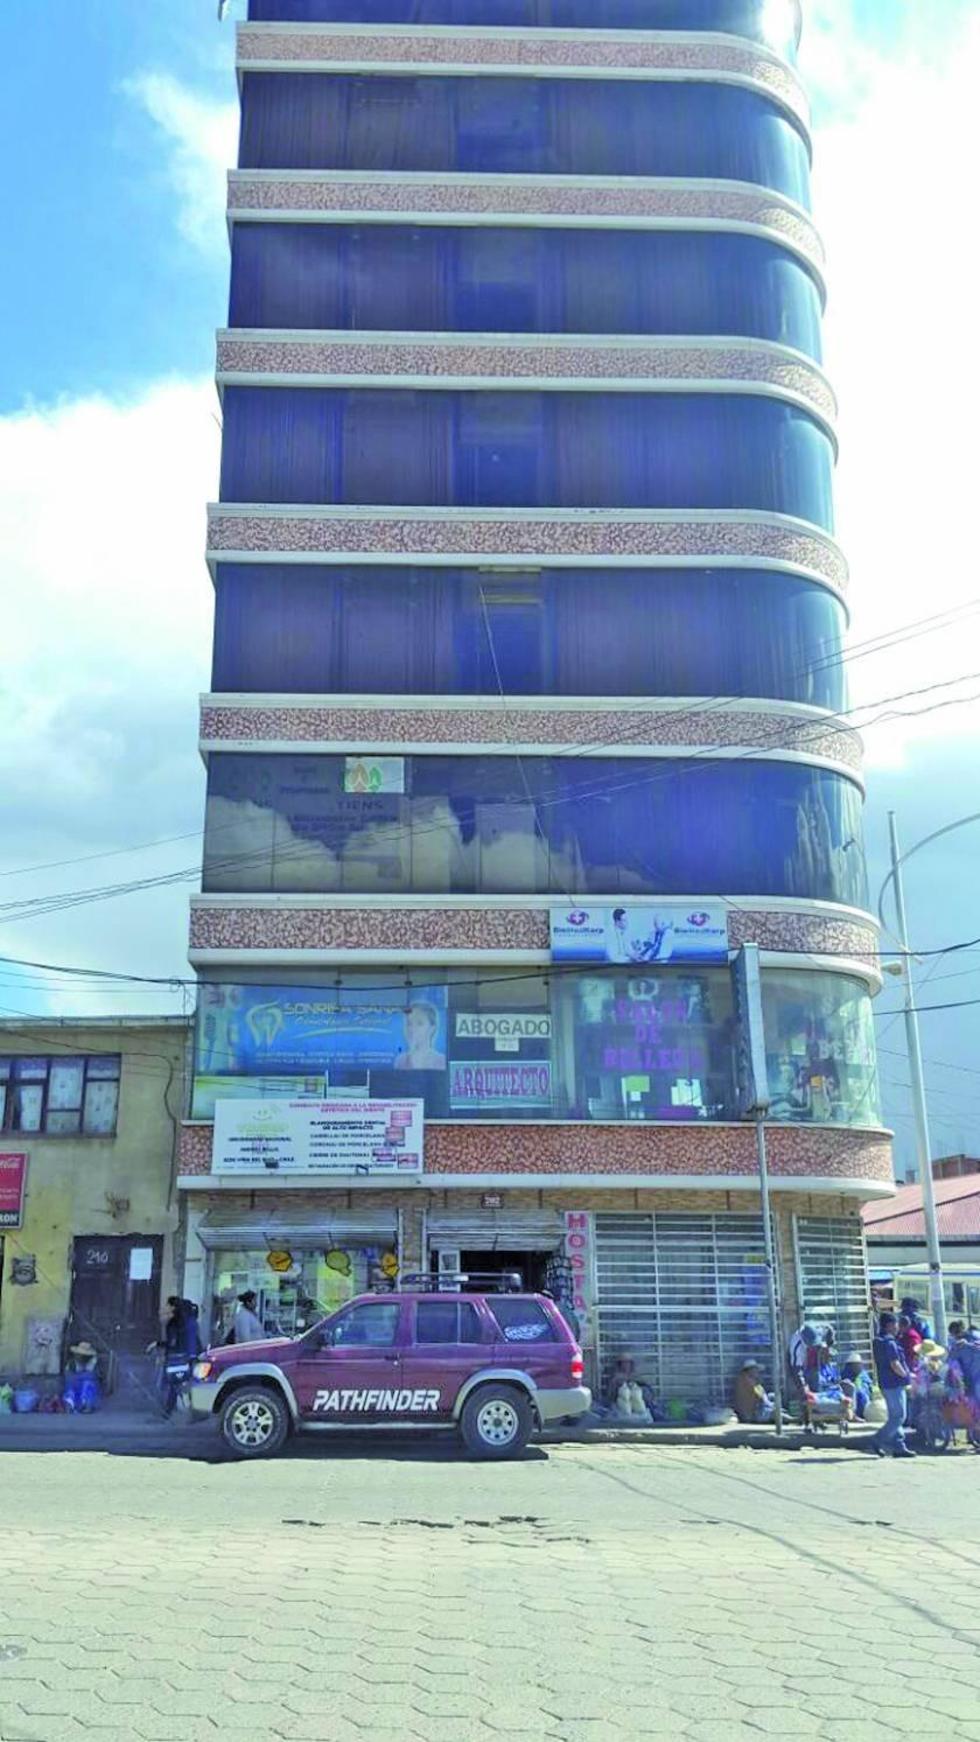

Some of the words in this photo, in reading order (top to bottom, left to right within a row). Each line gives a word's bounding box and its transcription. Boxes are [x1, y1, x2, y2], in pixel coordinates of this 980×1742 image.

[458, 1019, 550, 1035] ABOGADO
[635, 1024, 661, 1043] DE
[455, 1066, 549, 1098] ARQUITECTO
[312, 1389, 440, 1411] PATHFINDER
